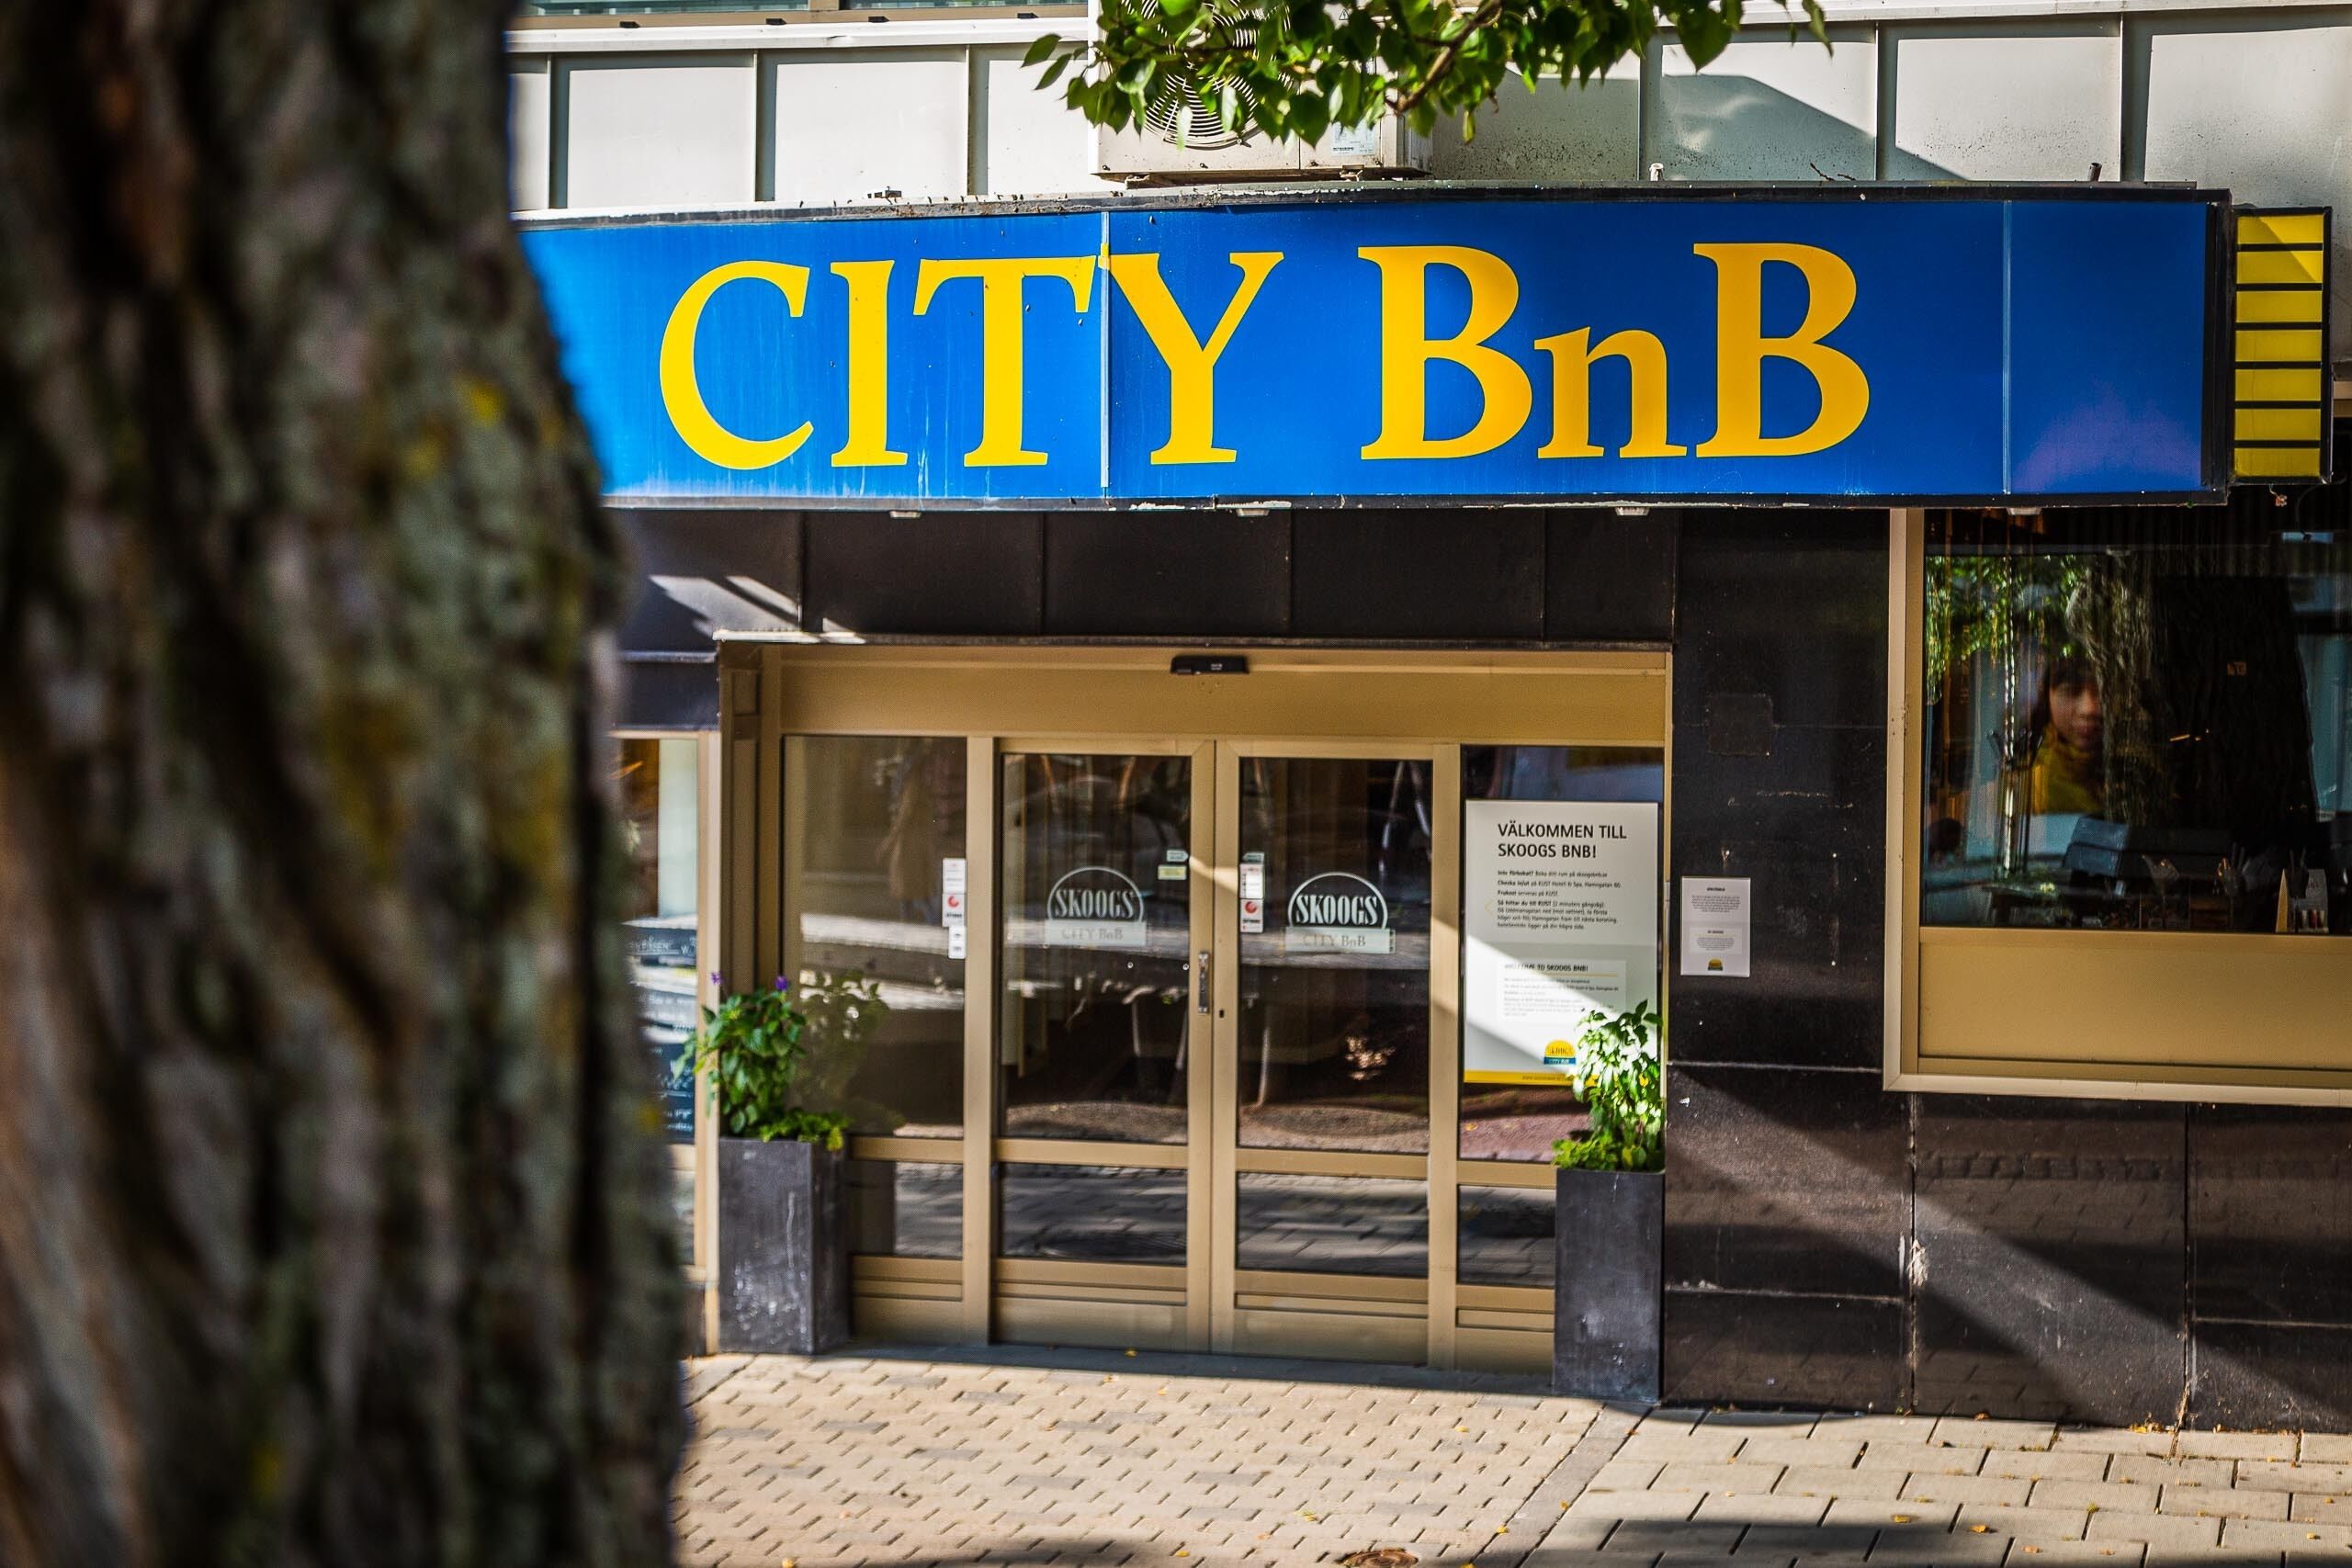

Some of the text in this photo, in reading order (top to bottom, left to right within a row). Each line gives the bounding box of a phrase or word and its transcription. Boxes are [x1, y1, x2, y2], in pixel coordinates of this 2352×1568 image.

[659, 243, 1871, 470] CITY BnB
[1498, 819, 1627, 840] VÄLKOMMEN TILL
[1498, 843, 1597, 858] SKOOGS BNB!
[1055, 888, 1135, 918] SKOOGS
[1295, 894, 1378, 925] SKOOGS
[1341, 934, 1366, 948] BnB
